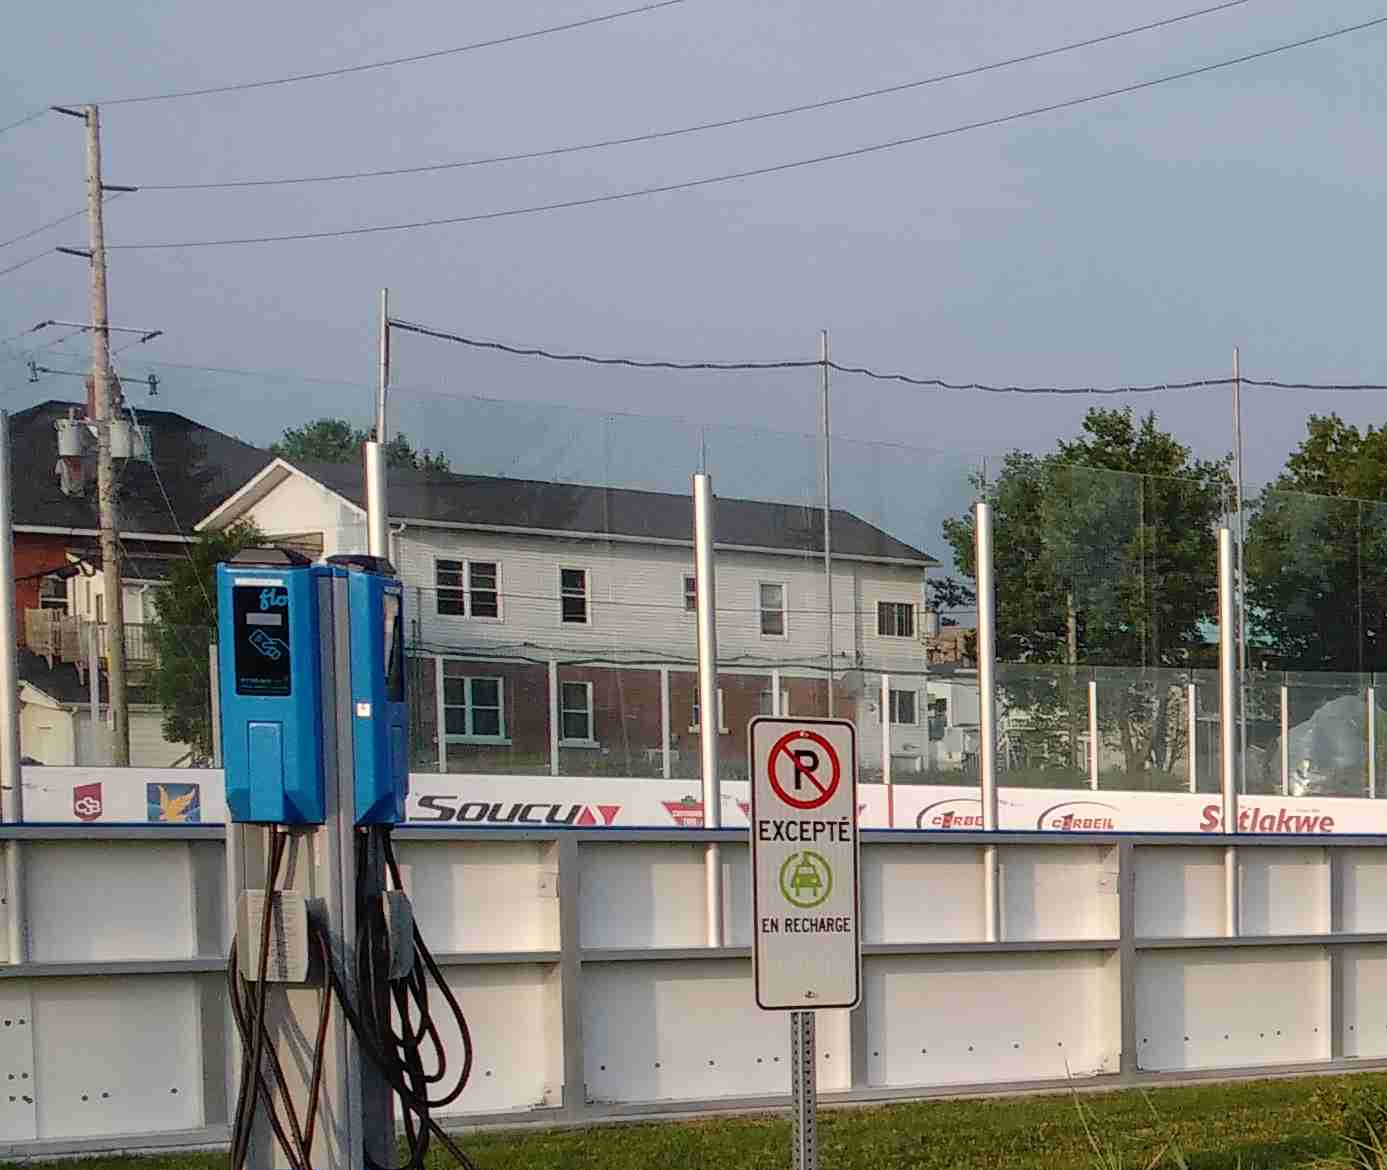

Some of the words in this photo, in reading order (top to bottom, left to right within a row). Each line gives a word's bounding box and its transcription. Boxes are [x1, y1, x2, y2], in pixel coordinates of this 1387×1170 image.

[259, 588, 288, 610] flo
[759, 817, 850, 841] EXCEPTÉ
[1200, 805, 1334, 832] Stlakwe
[762, 918, 778, 933] EN
[785, 917, 850, 934] RECHARGE
